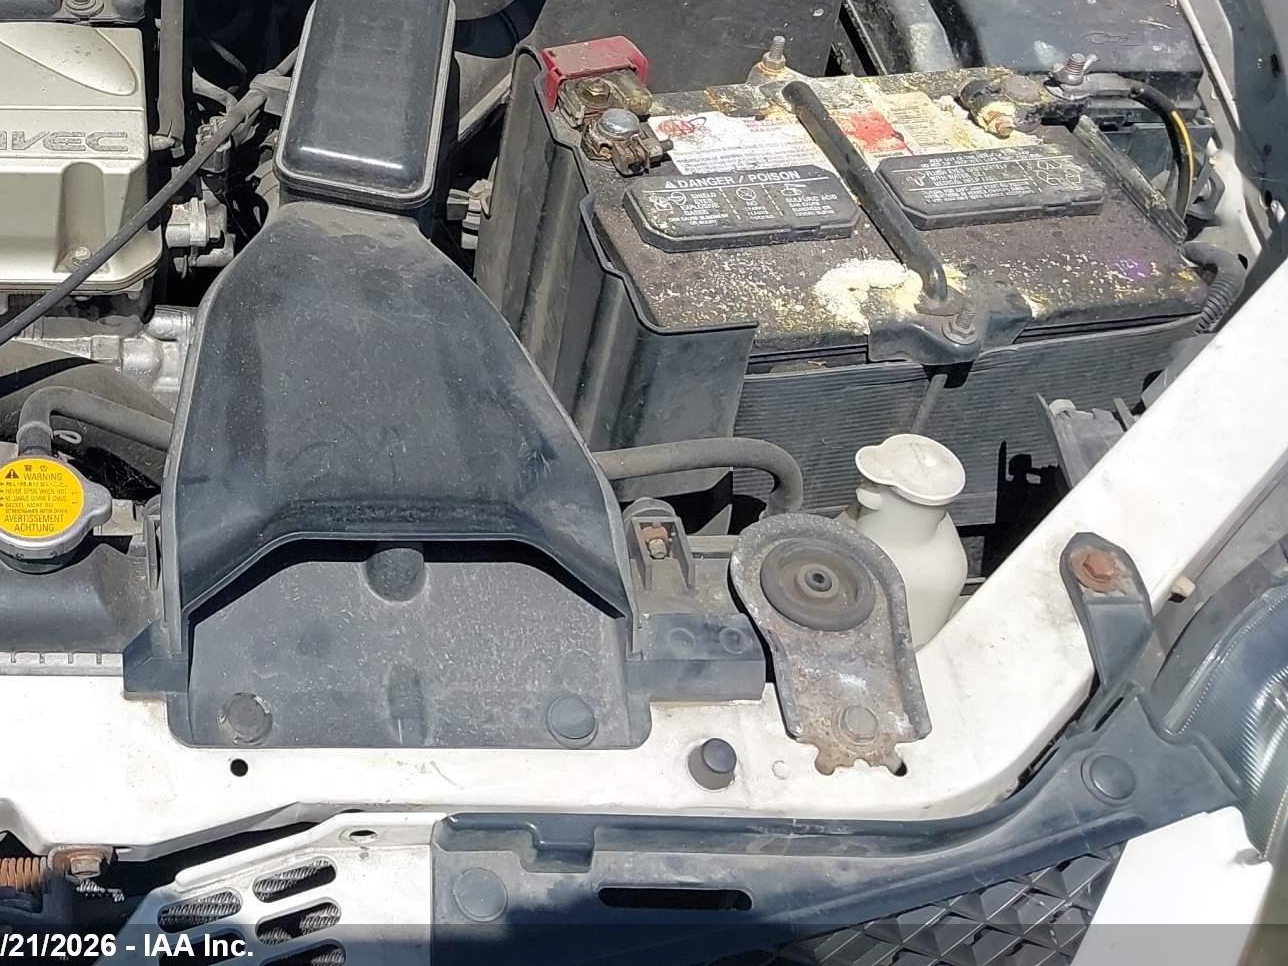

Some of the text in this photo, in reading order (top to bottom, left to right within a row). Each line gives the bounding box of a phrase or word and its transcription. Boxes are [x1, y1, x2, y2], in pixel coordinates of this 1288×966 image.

[678, 176, 734, 189] DANGER
[750, 170, 801, 183] POISON
[23, 472, 63, 481] WARNING
[4, 514, 65, 523] AVERTISSEMENT
[14, 523, 55, 533] ACHTUNG
